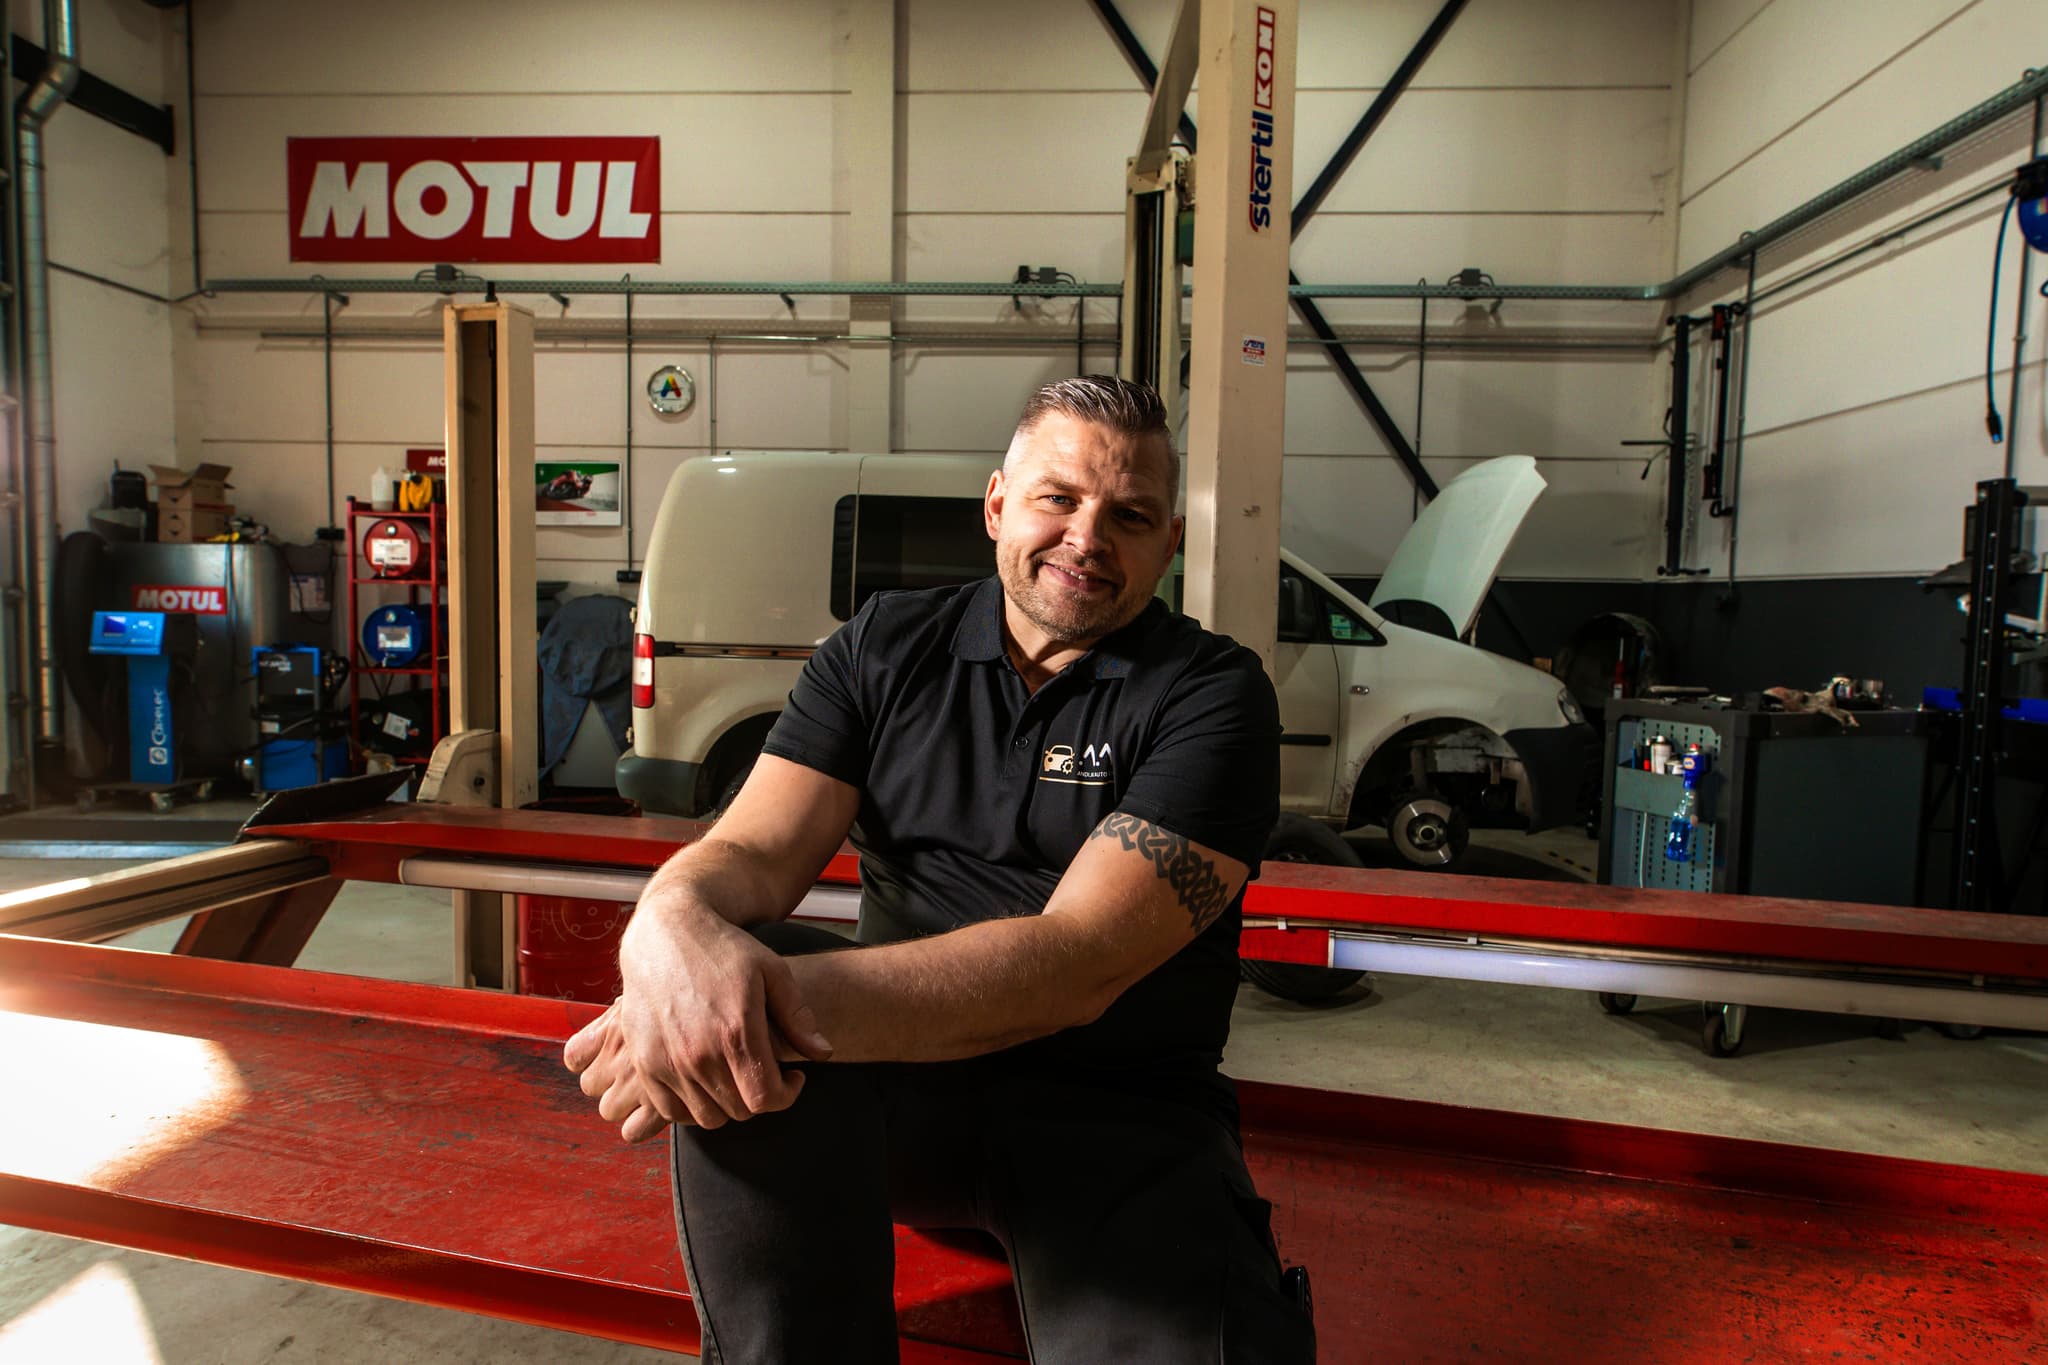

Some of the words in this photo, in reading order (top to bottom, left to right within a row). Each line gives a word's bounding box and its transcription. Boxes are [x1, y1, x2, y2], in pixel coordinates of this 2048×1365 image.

[1257, 10, 1274, 107] KONI
[299, 160, 652, 241] MOTUL
[1250, 110, 1274, 230] stertil
[137, 589, 222, 611] MOTUL
